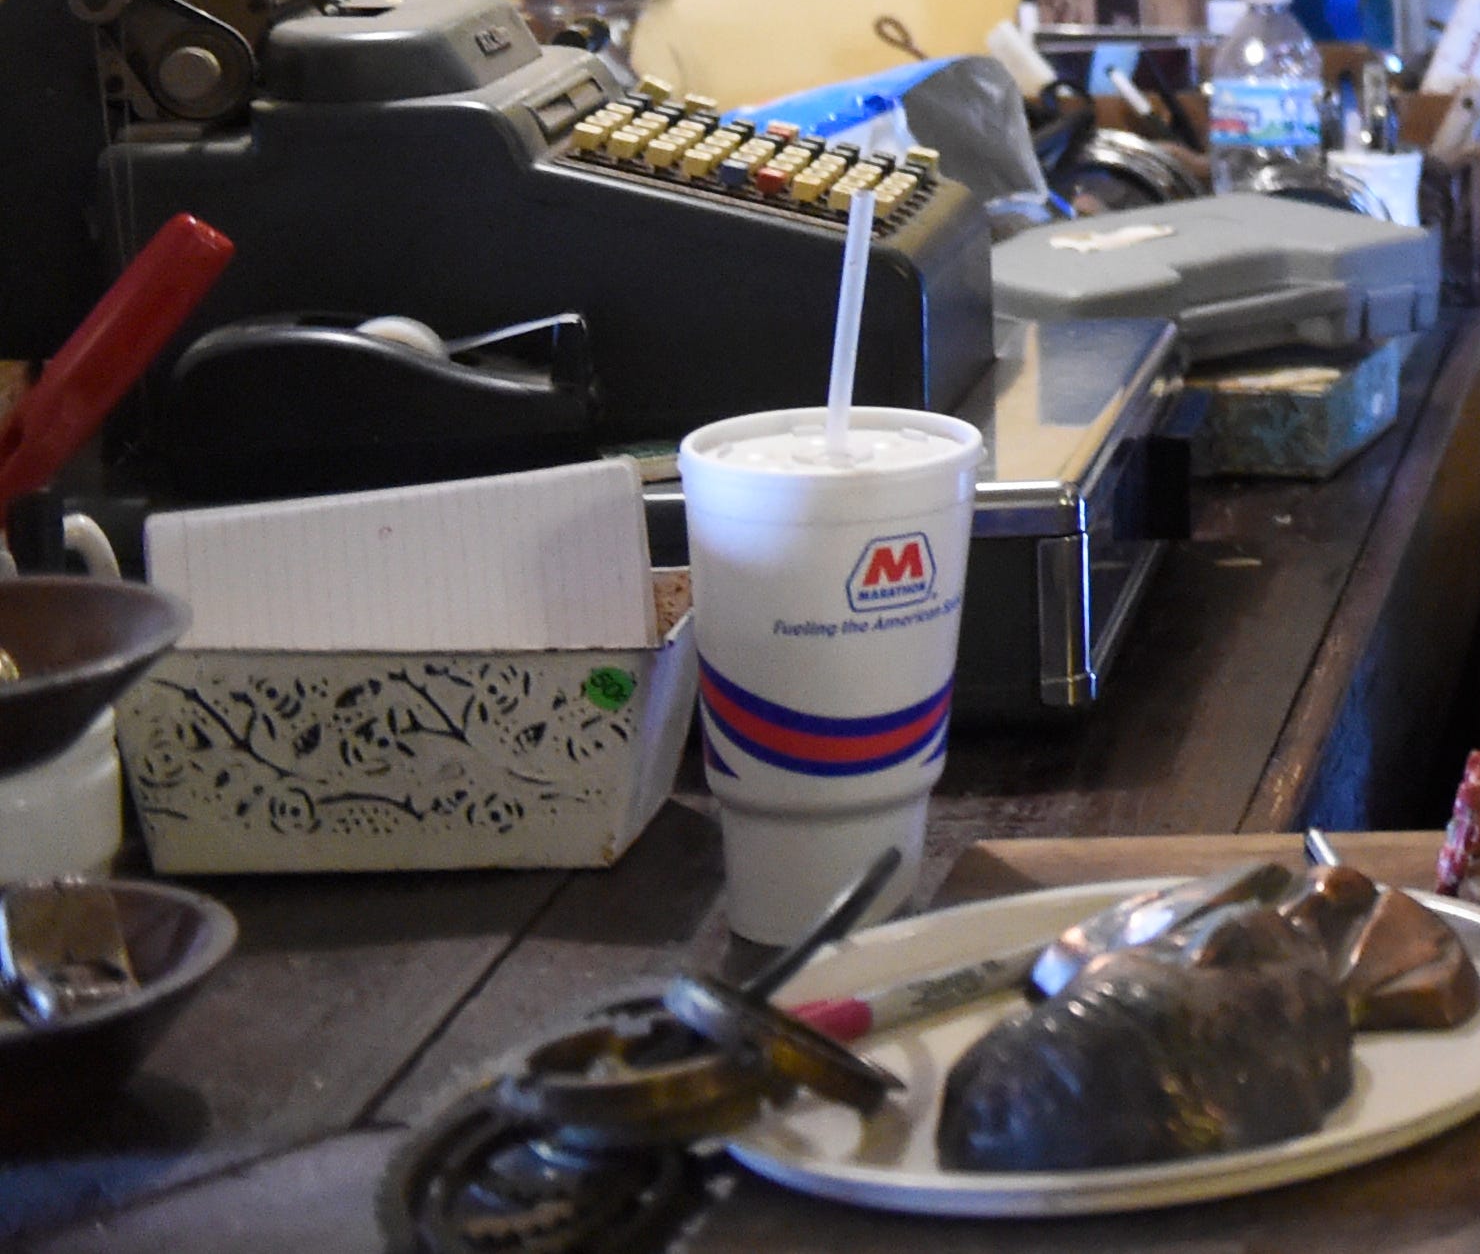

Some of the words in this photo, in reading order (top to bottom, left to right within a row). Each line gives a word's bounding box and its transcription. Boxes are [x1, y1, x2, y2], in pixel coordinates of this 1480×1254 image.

[862, 541, 924, 587] M
[857, 582, 926, 602] MARATHON
[773, 619, 837, 637] Fueling
[842, 620, 869, 634] the
